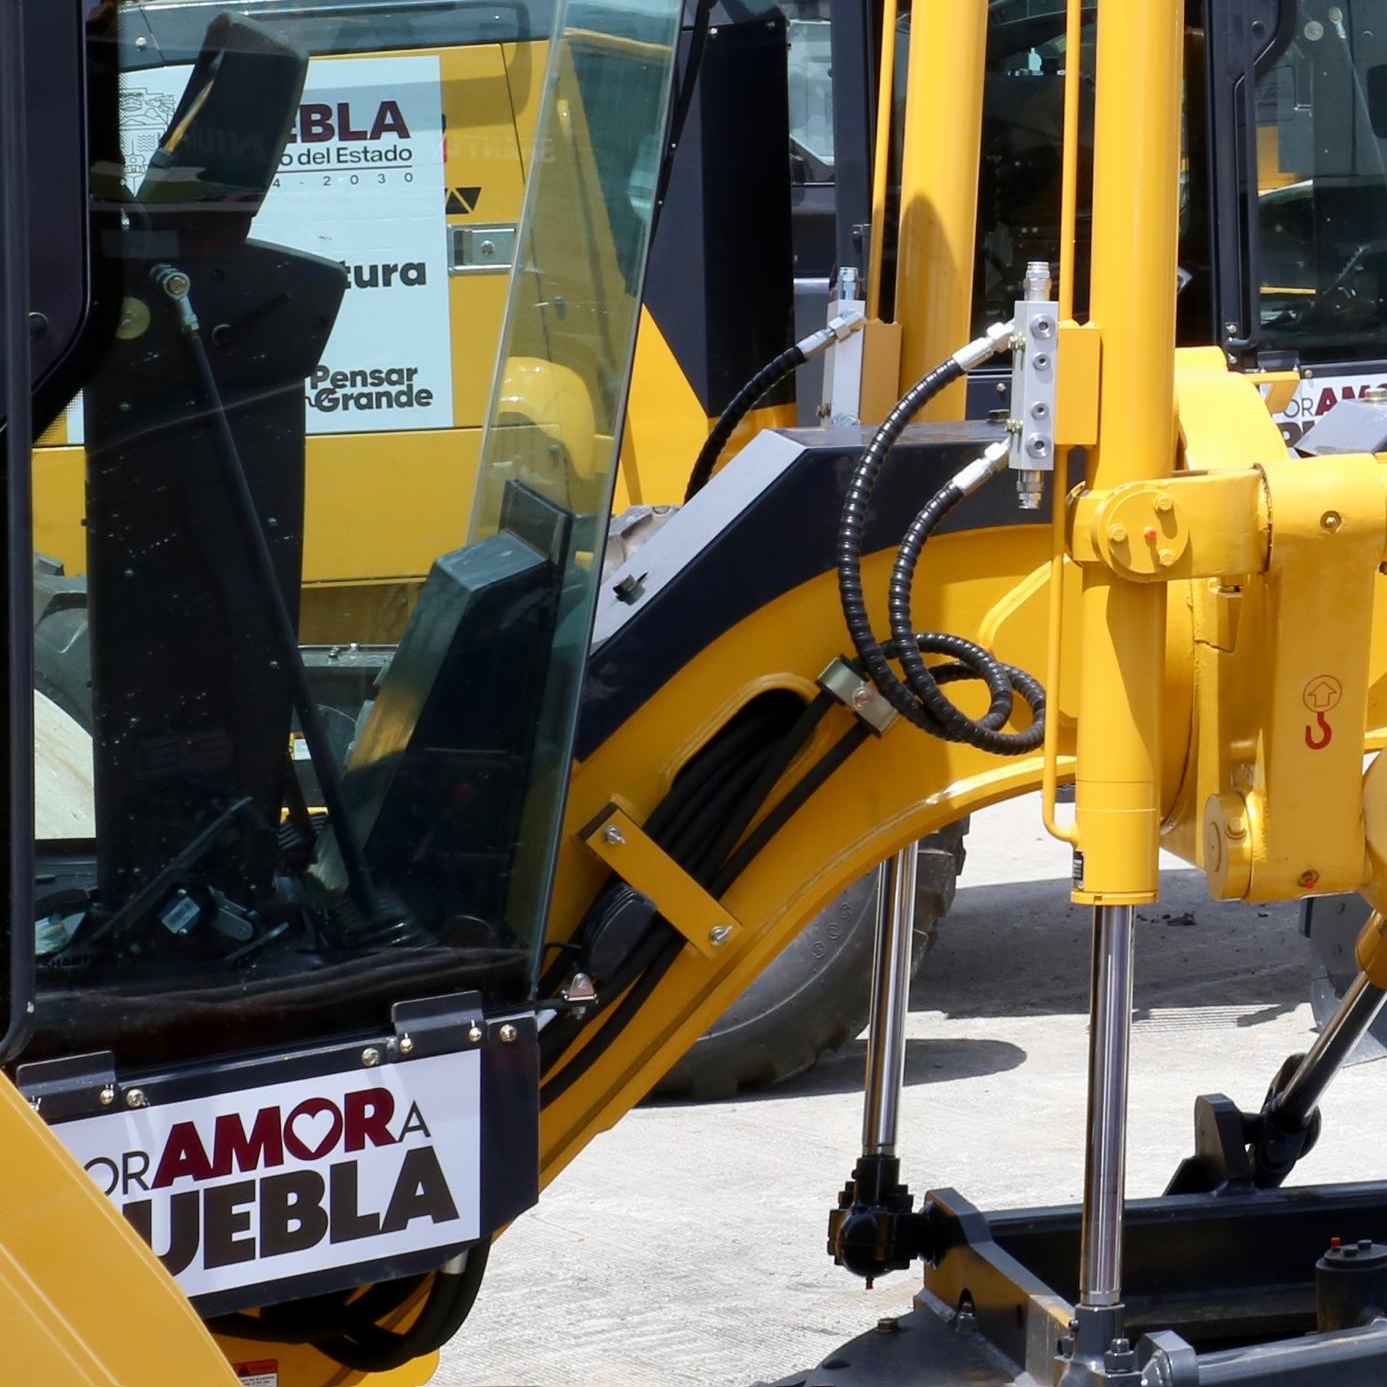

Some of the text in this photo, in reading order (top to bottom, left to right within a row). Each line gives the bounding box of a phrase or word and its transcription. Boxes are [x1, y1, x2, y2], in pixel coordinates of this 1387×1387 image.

[298, 145, 413, 166] del Estado
[308, 365, 418, 390] Pensar
[314, 385, 433, 412] Grande
[1284, 398, 1315, 418] OR
[85, 1087, 431, 1197] OR AMOR A
[122, 1145, 460, 1277] UEBLA
